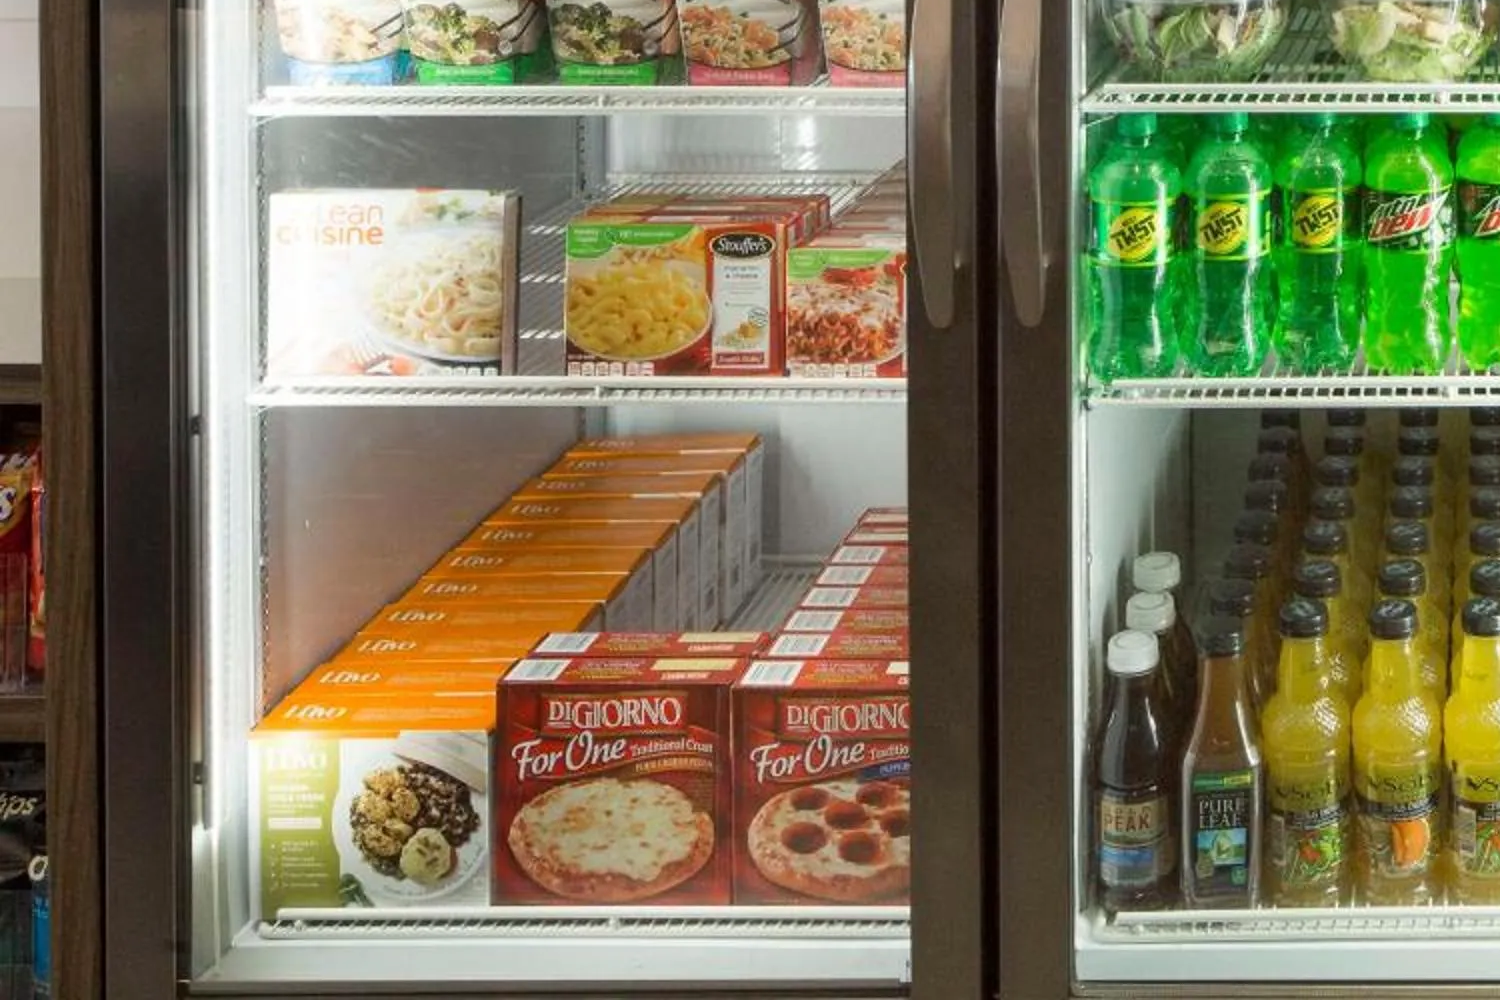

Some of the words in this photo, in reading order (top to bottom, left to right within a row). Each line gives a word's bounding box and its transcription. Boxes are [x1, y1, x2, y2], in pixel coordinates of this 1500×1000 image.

[717, 237, 768, 255] Stouffer's
[549, 697, 682, 728] DIGIORNO
[512, 738, 563, 780] For
[566, 732, 627, 770] One
[750, 742, 801, 785] For
[805, 734, 865, 773] One
[1200, 799, 1245, 813] PURE
[1104, 814, 1150, 832] PEAK
